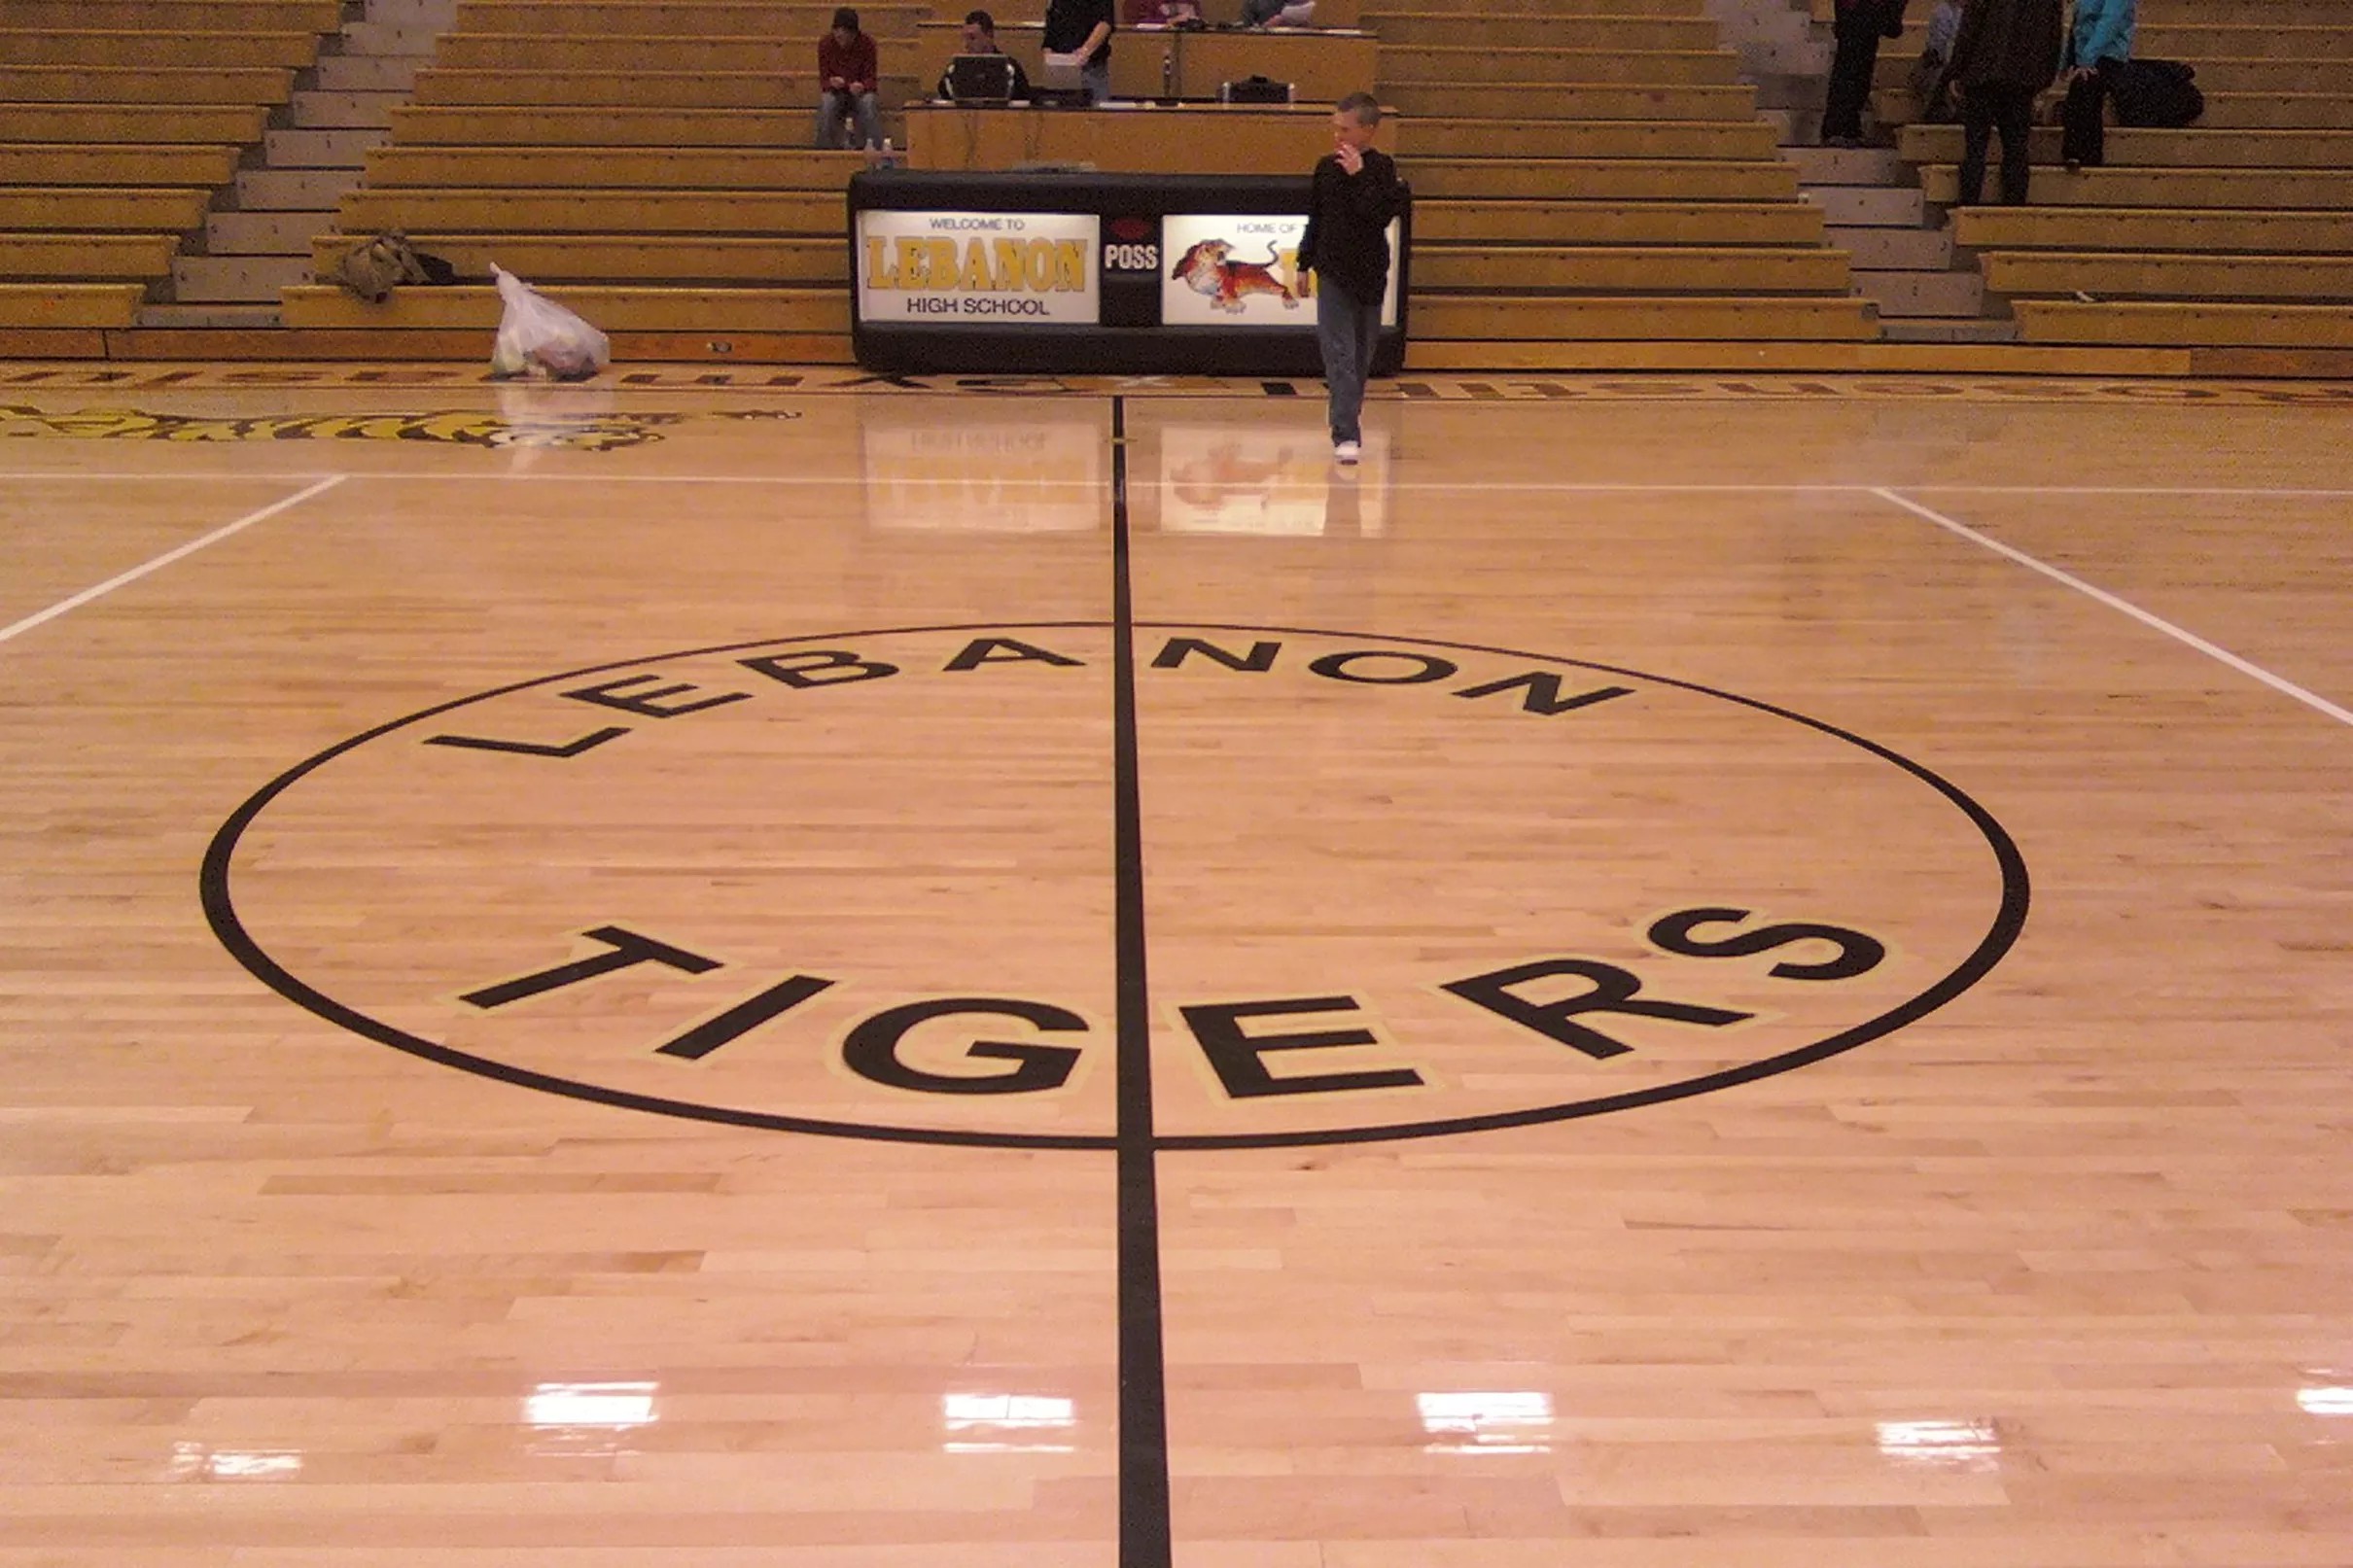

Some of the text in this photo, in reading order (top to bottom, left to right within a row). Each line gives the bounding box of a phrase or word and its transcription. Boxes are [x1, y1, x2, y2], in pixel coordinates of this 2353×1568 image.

[929, 217, 1026, 231] WELCOME TO
[1236, 223, 1298, 234] HOME OF
[866, 235, 1088, 293] LEBANON
[1105, 244, 1158, 269] POSS
[906, 297, 1051, 316] HIGH SCHOOL
[423, 637, 1637, 758] LEBANON
[457, 906, 1886, 1099] TIGERS
